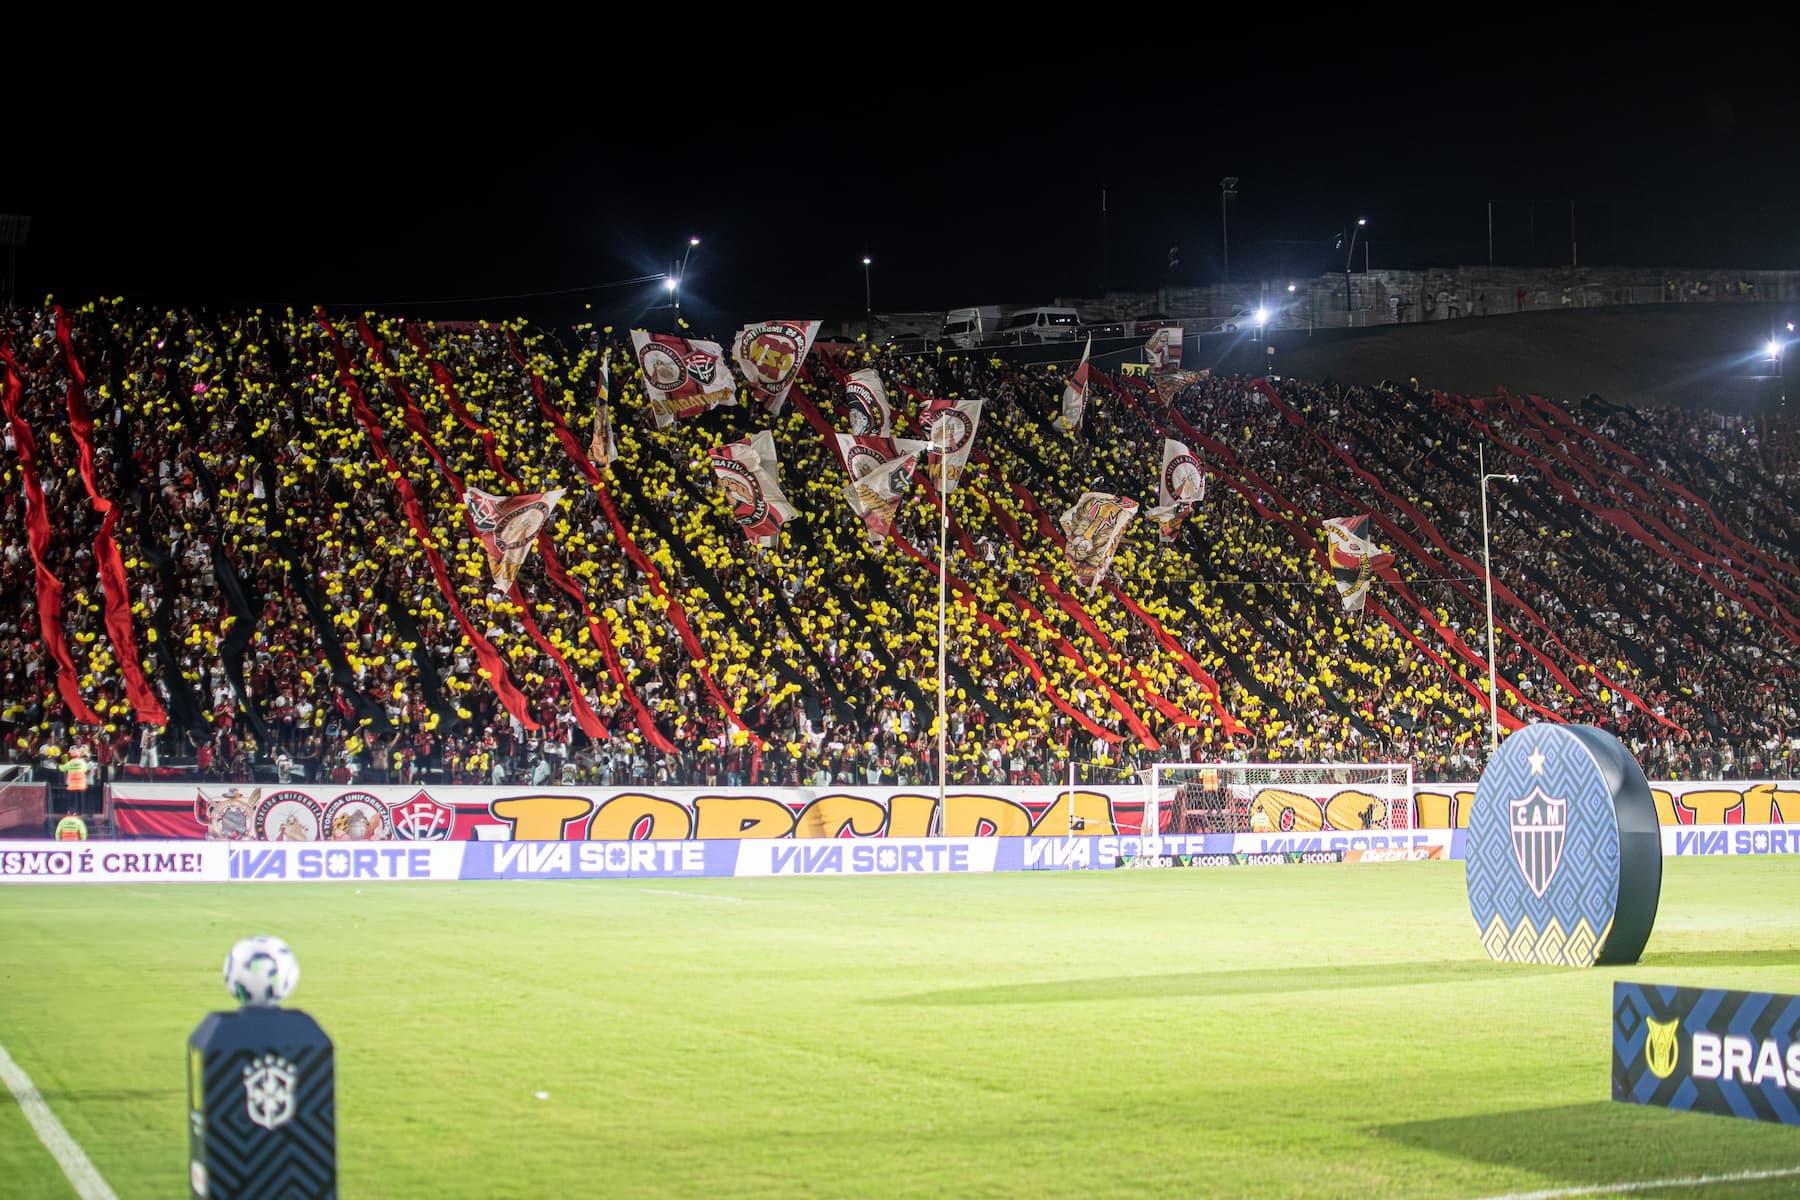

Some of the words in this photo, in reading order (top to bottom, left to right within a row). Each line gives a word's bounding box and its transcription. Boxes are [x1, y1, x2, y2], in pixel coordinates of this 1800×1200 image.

[323, 799, 344, 830] TORCIDA
[490, 793, 1118, 839] TORCIDA
[1517, 804, 1559, 825] CAM
[1024, 837, 1090, 866] VIVA
[1676, 831, 1728, 855] VIVA
[78, 848, 94, 873] É
[102, 853, 202, 873] CRIME!
[297, 849, 430, 878] SORTE
[493, 843, 566, 873] VIVA
[580, 842, 705, 872] SORTE
[771, 846, 842, 873] VIVA
[853, 844, 969, 872] SORTE
[1192, 855, 1230, 867] SICOOB
[1248, 854, 1285, 865] SICOOB
[1302, 853, 1338, 863] SICOOB
